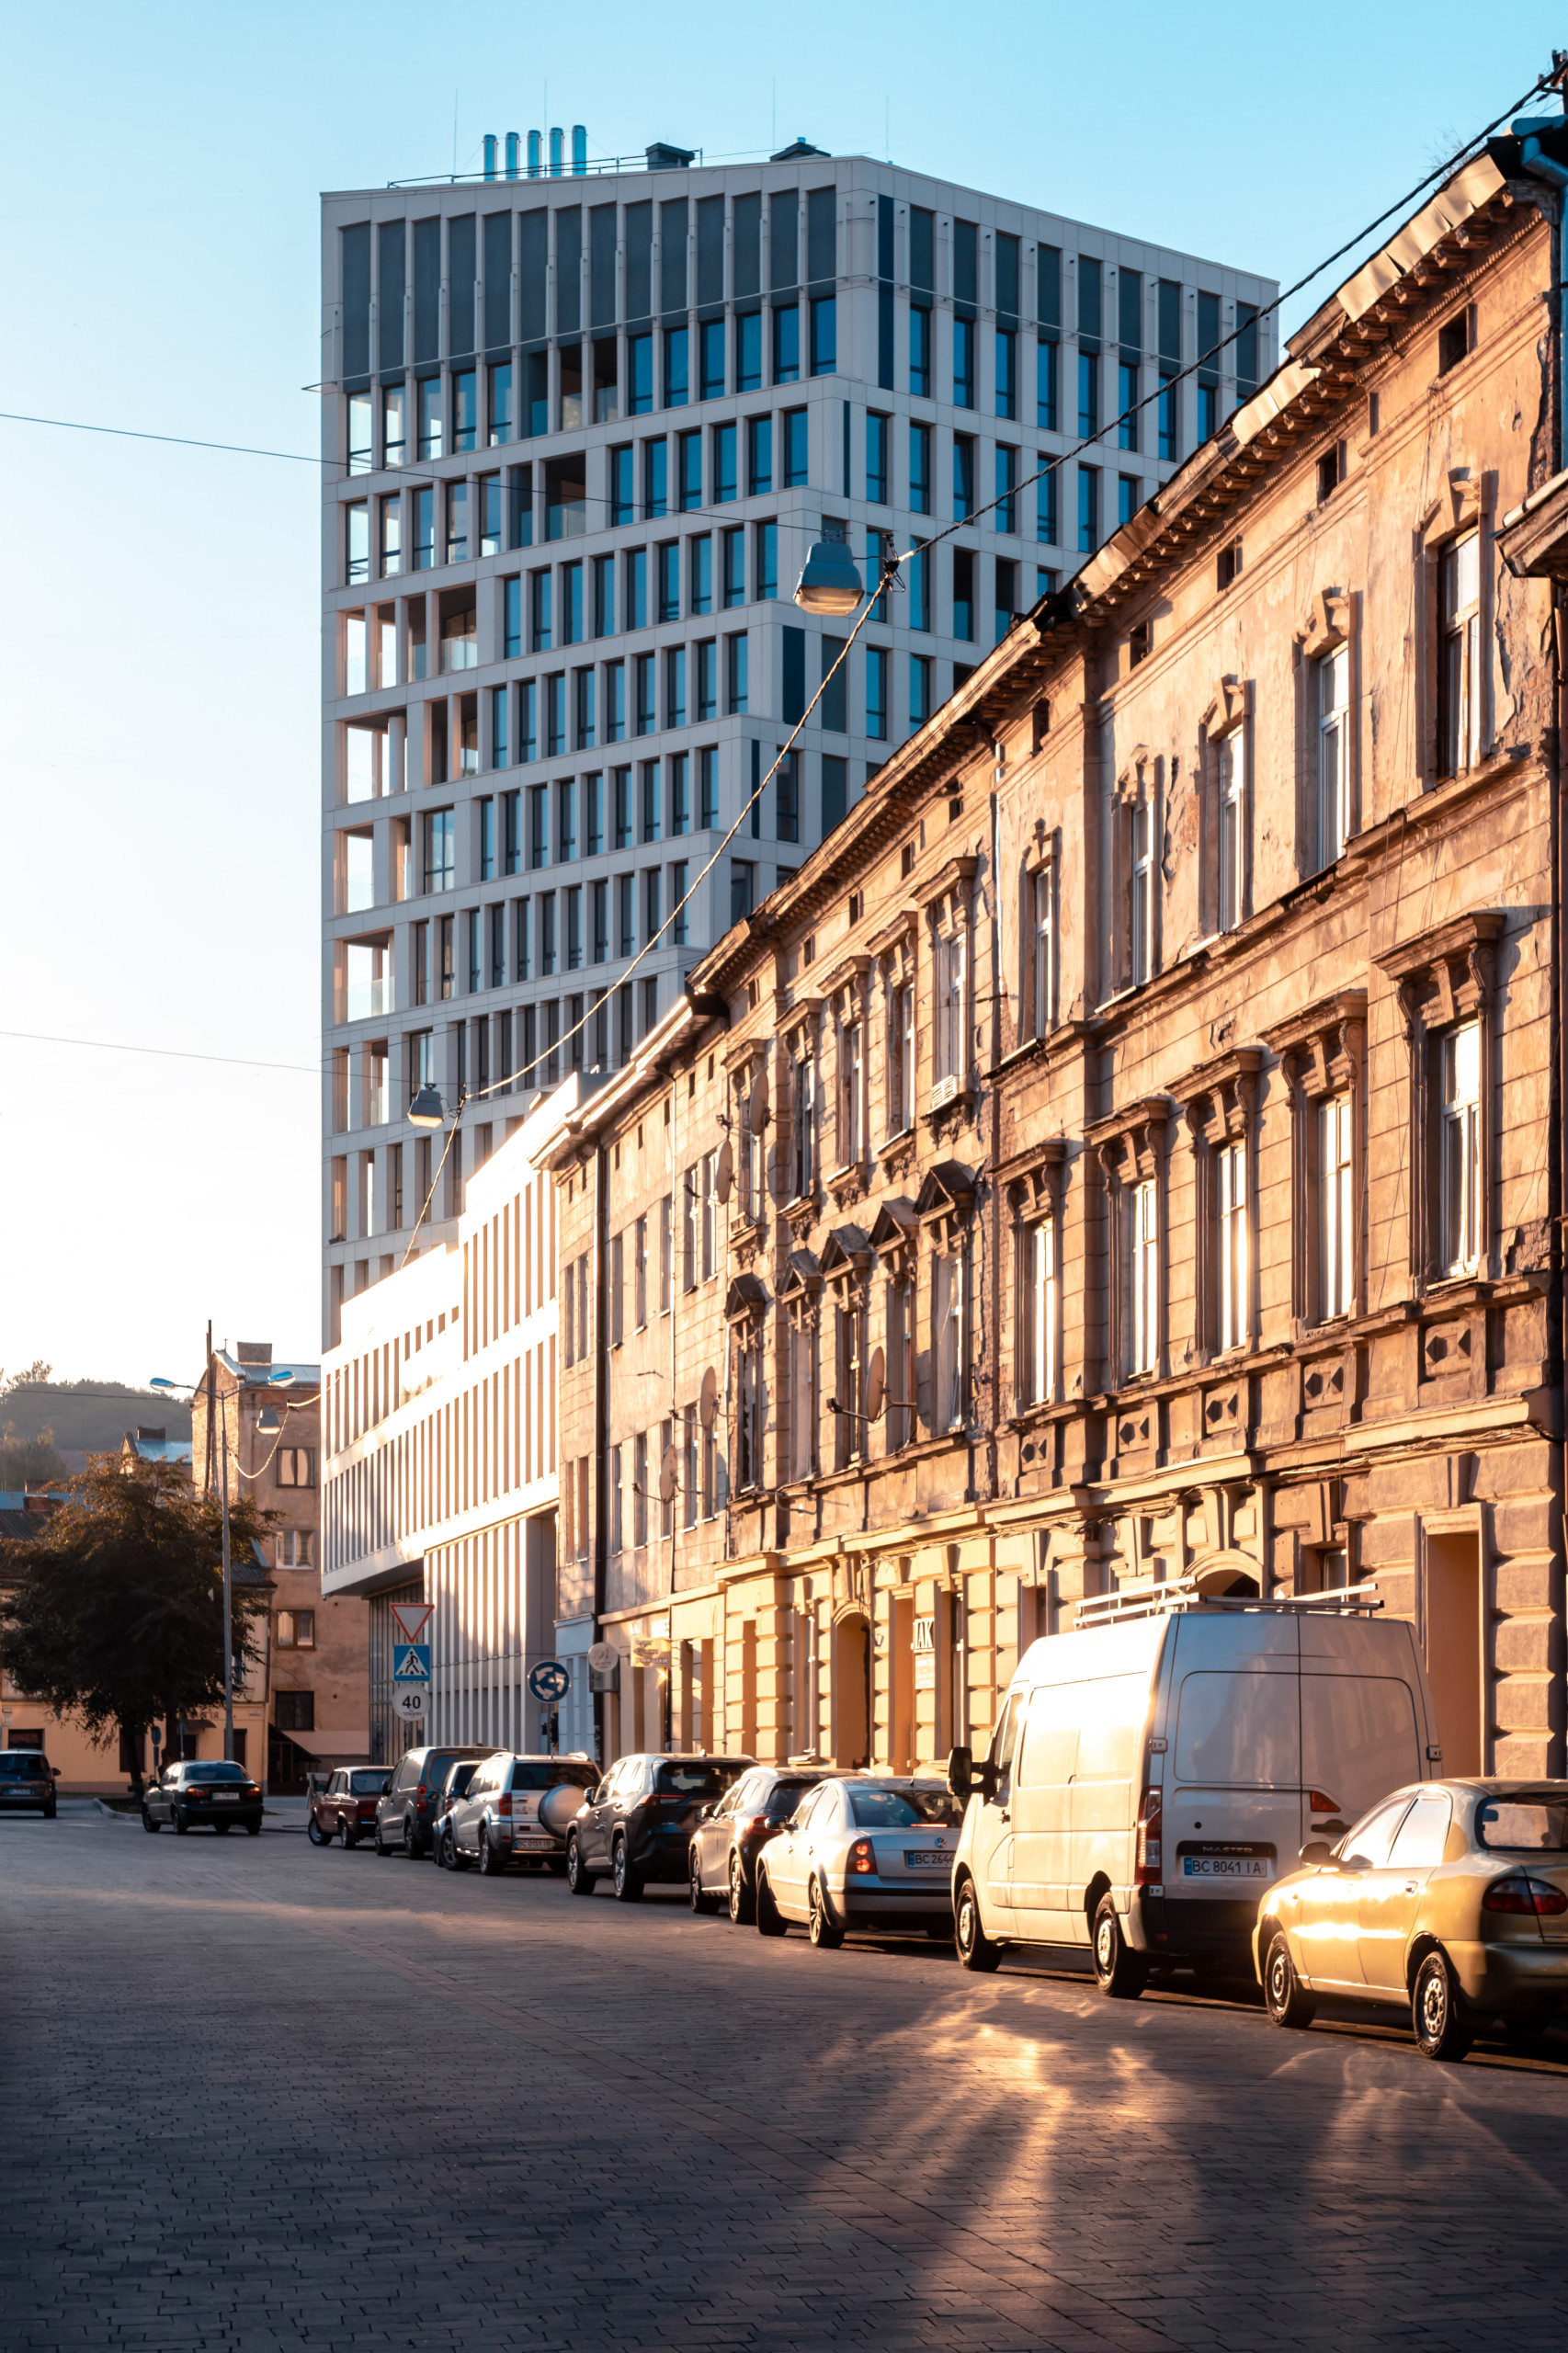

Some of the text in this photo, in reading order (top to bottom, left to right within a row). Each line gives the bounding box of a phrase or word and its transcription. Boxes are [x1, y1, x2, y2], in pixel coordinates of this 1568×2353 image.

[402, 1695, 421, 1710] 40
[915, 1854, 930, 1864] BC
[1192, 1859, 1210, 1873] BC
[1213, 1860, 1241, 1873] 8041
